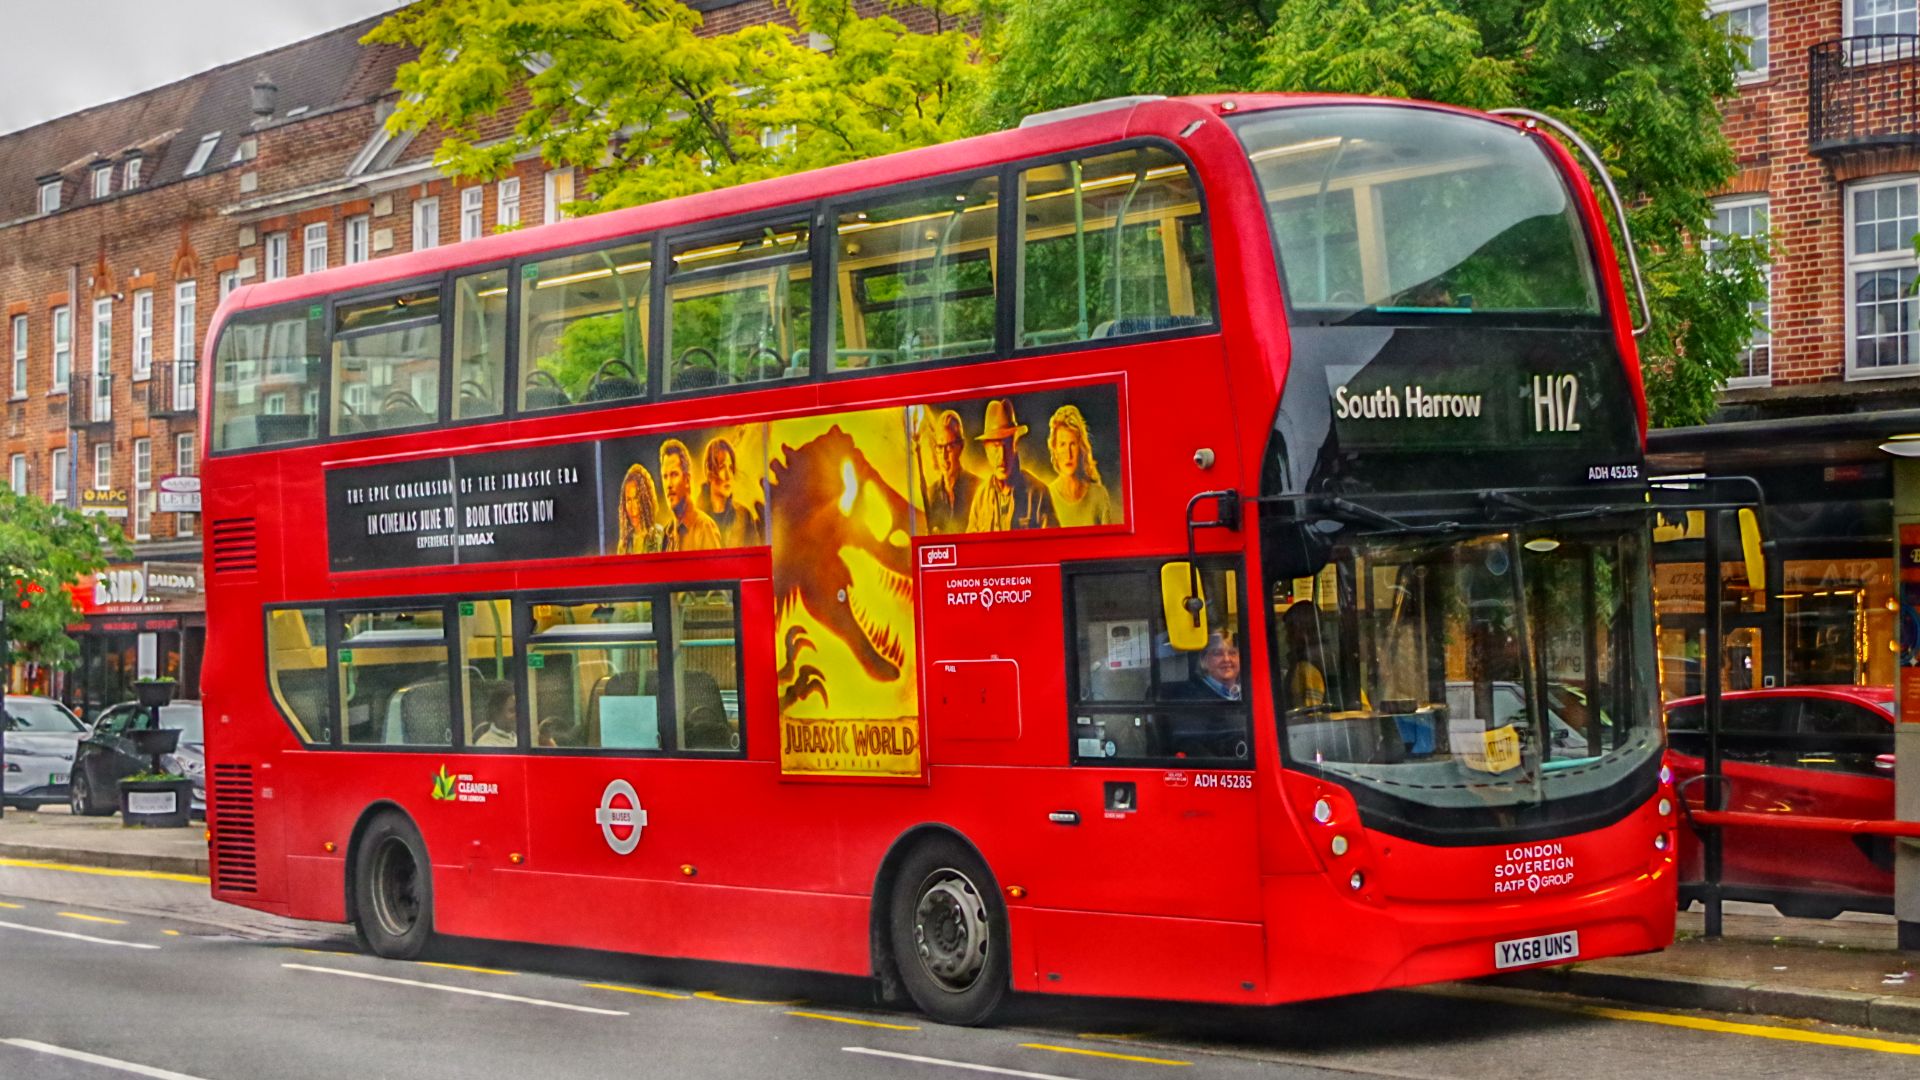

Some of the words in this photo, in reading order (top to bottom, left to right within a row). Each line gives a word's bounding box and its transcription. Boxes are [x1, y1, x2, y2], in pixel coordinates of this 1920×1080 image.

[1336, 385, 1400, 419] South
[1405, 385, 1482, 418] Harrow
[1533, 374, 1581, 432] H12
[1588, 467, 1609, 480] ADH
[1610, 465, 1638, 479] 45285
[347, 489, 364, 504] THE
[368, 485, 390, 502] EPIC
[395, 479, 453, 500] CONCLUSION
[461, 477, 473, 493] OF
[478, 475, 496, 492] THE
[502, 469, 552, 490] JURASSIC
[557, 467, 579, 484] ERA
[367, 514, 378, 535] IN
[379, 510, 418, 534] CINEMAS
[420, 508, 442, 530] JUNE
[444, 506, 455, 528] 10
[465, 505, 491, 528] BOOK
[493, 501, 529, 525] TICKETS
[532, 499, 554, 522] NOW
[417, 535, 449, 549] EXPERIENCE
[465, 532, 495, 546] IMAX
[927, 548, 949, 564] global
[946, 579, 981, 588] LONDON
[983, 576, 1032, 587] SOVEREIGN
[947, 592, 978, 606] RATP
[994, 589, 1032, 604] GROUP
[944, 665, 957, 673] FUEL
[785, 722, 850, 755] JURASSIC
[852, 723, 916, 757] WORLD
[1194, 774, 1218, 788] ADH
[1220, 775, 1253, 789] 45285
[611, 812, 631, 822] BUSES
[1505, 844, 1562, 861] LONDON
[1494, 857, 1574, 878] SOVEREIGN
[1494, 879, 1525, 893] RATP
[1541, 873, 1574, 887] GROUP
[1502, 939, 1541, 963] YX68
[1544, 935, 1572, 957] UNS
